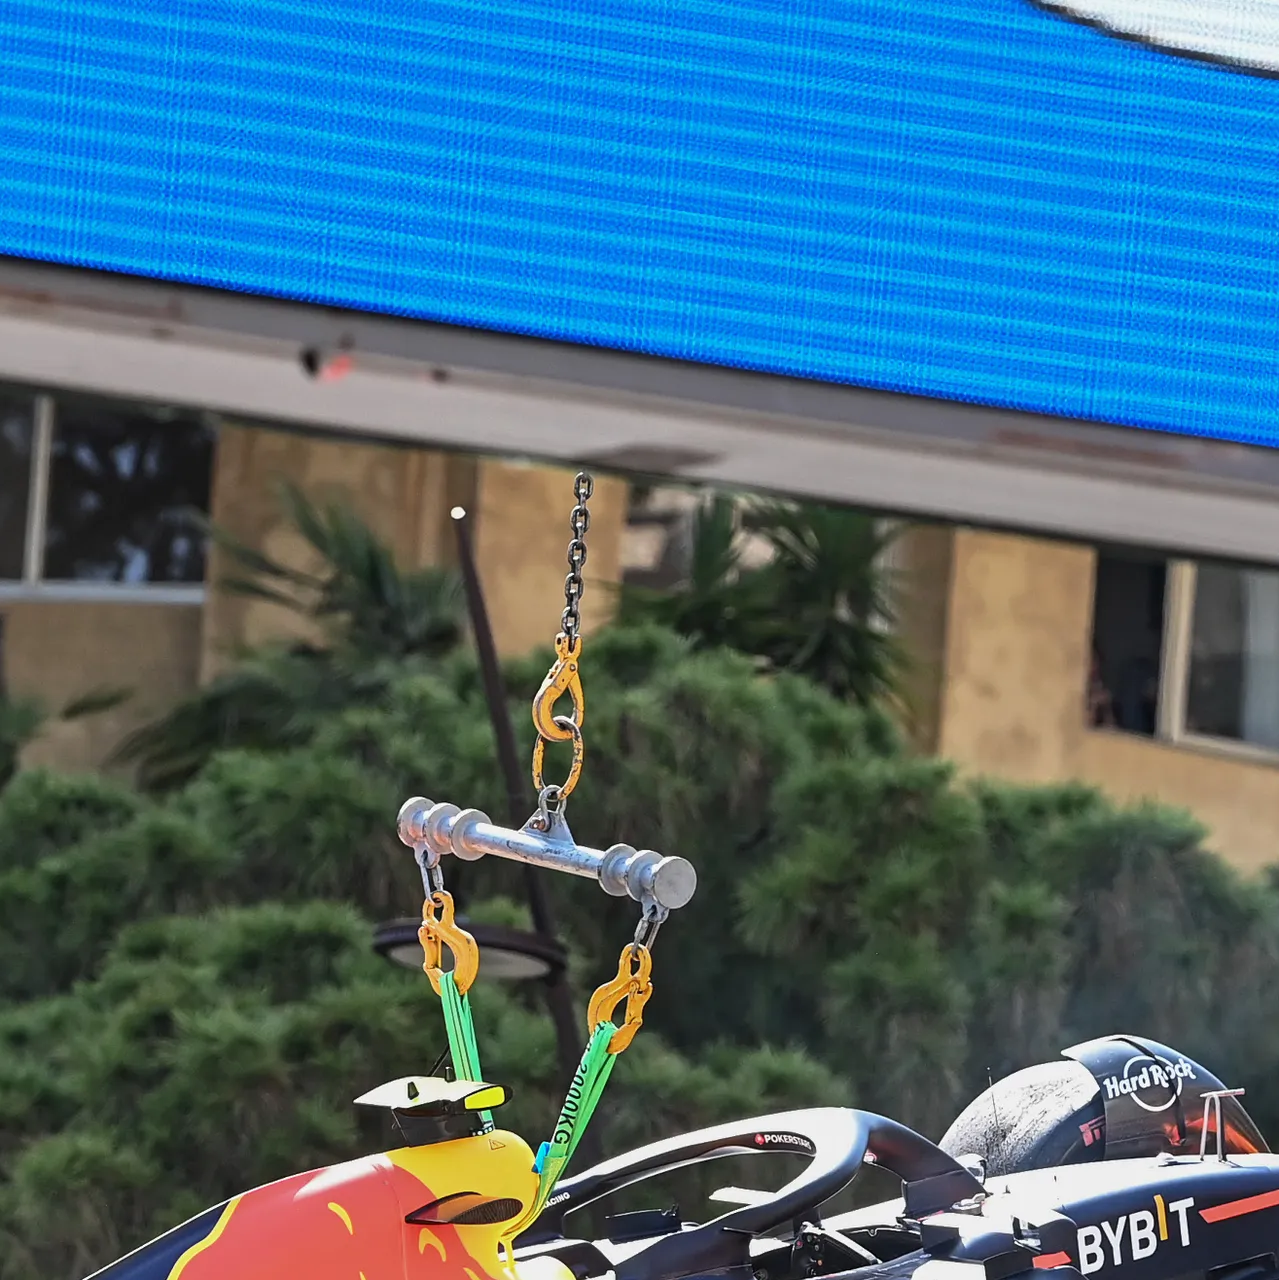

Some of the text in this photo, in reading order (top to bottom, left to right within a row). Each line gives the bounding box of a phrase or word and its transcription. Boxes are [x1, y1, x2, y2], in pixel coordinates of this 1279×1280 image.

[553, 1063, 588, 1146] 2000KG
[1103, 1058, 1197, 1099] Hard Rock
[1076, 1194, 1195, 1275] BYBIT
